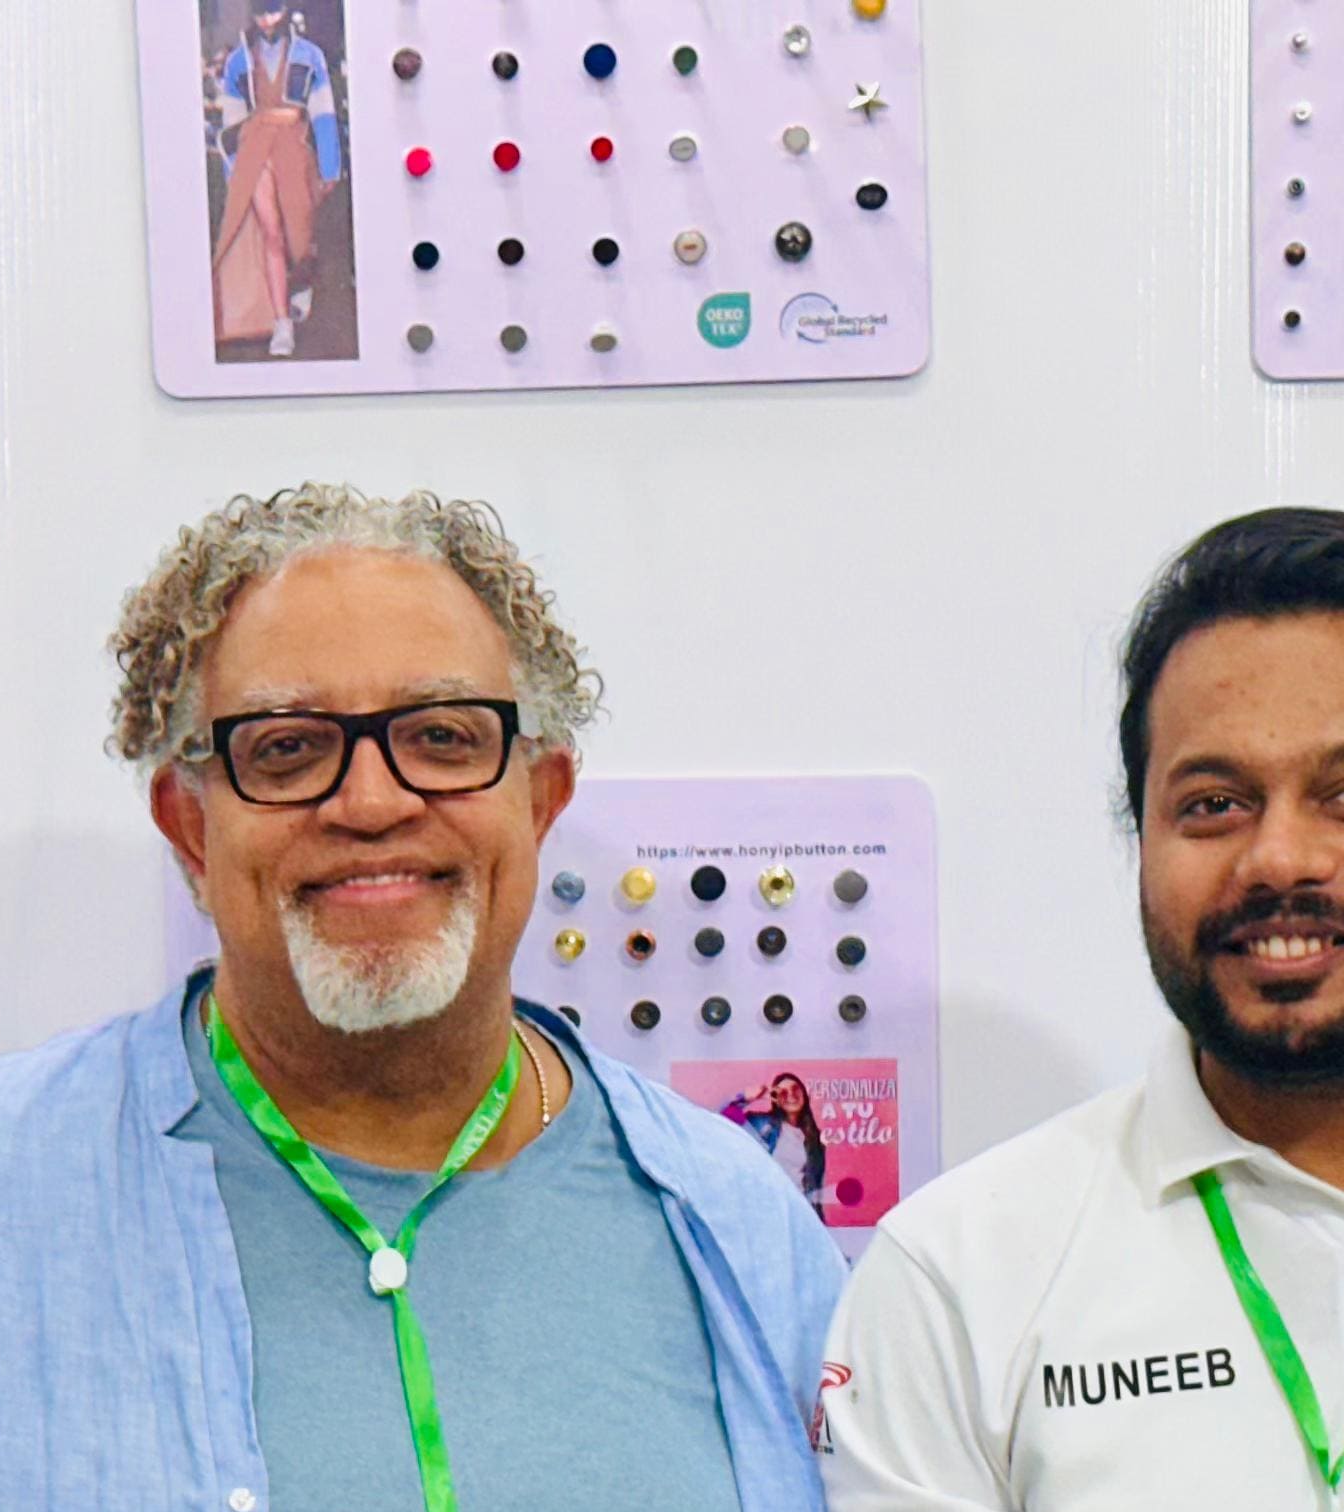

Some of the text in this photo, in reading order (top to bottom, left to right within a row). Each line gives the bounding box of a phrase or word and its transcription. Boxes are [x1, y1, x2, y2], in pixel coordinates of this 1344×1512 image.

[798, 313, 889, 329] Global Recycled
[841, 1101, 874, 1119] TU
[819, 1117, 893, 1147] estilo
[1042, 1347, 1237, 1409] MUNEEB
